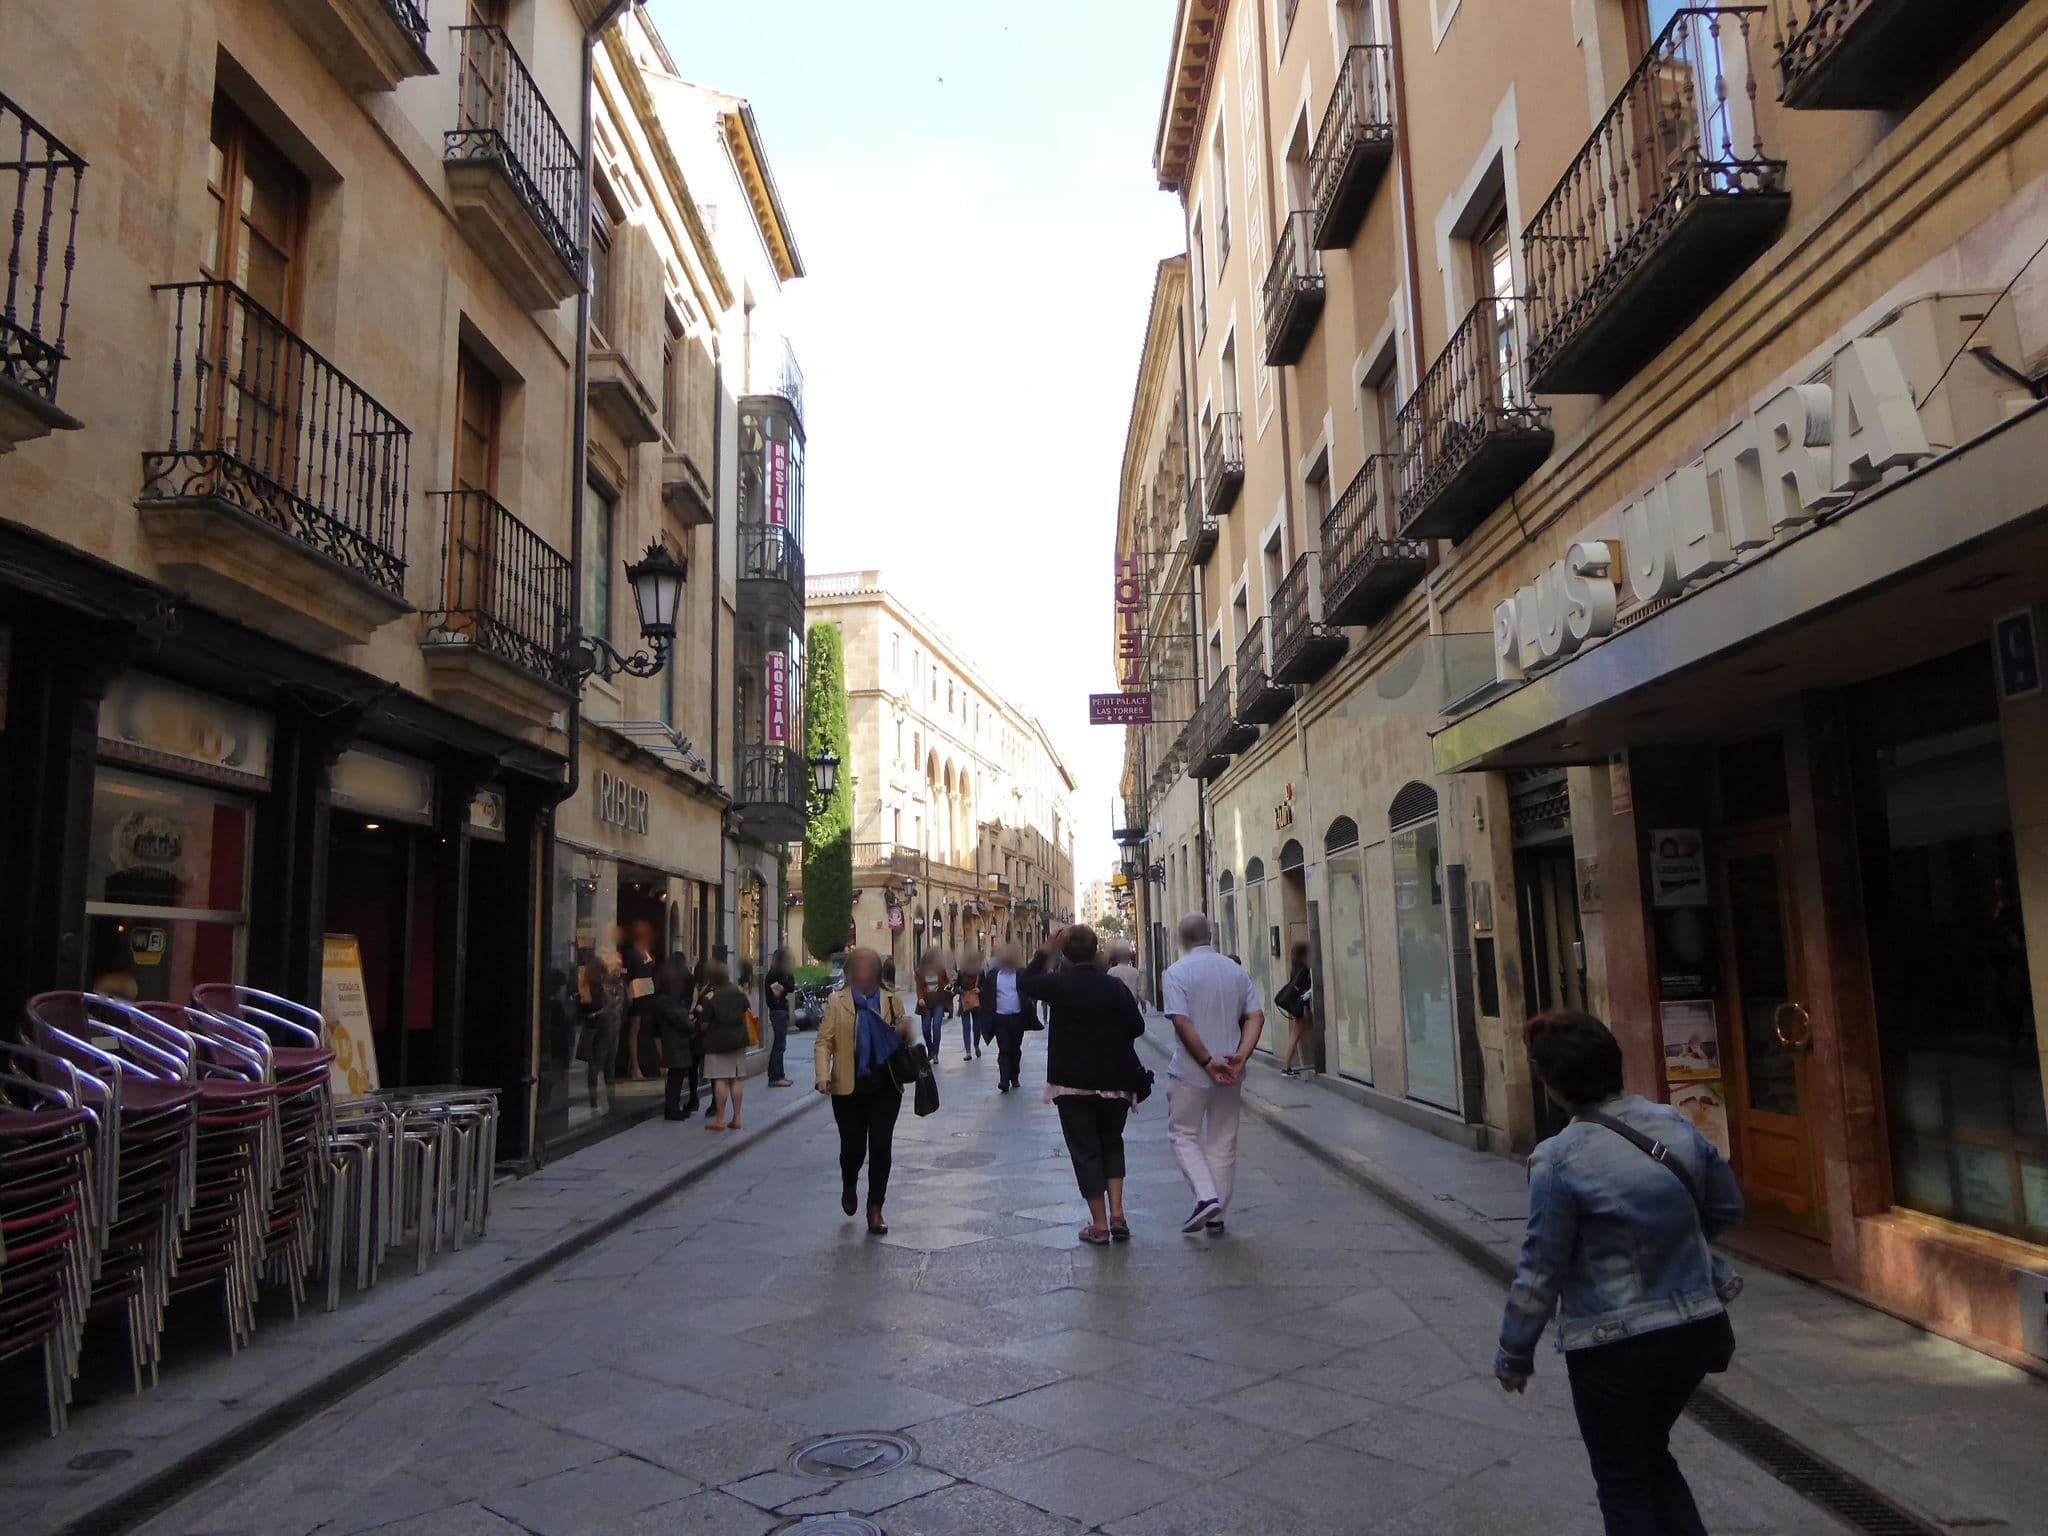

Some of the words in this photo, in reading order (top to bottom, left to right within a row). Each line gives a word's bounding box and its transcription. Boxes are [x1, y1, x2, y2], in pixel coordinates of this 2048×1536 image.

[775, 444, 785, 522] HOSTAL
[1492, 541, 1617, 684] PLUS
[1622, 336, 1934, 602] ULTRA
[773, 656, 784, 738] HOSTAL
[1092, 698, 1115, 706] PETIT
[1116, 697, 1148, 705] PALACE
[1112, 707, 1144, 715] TORRES
